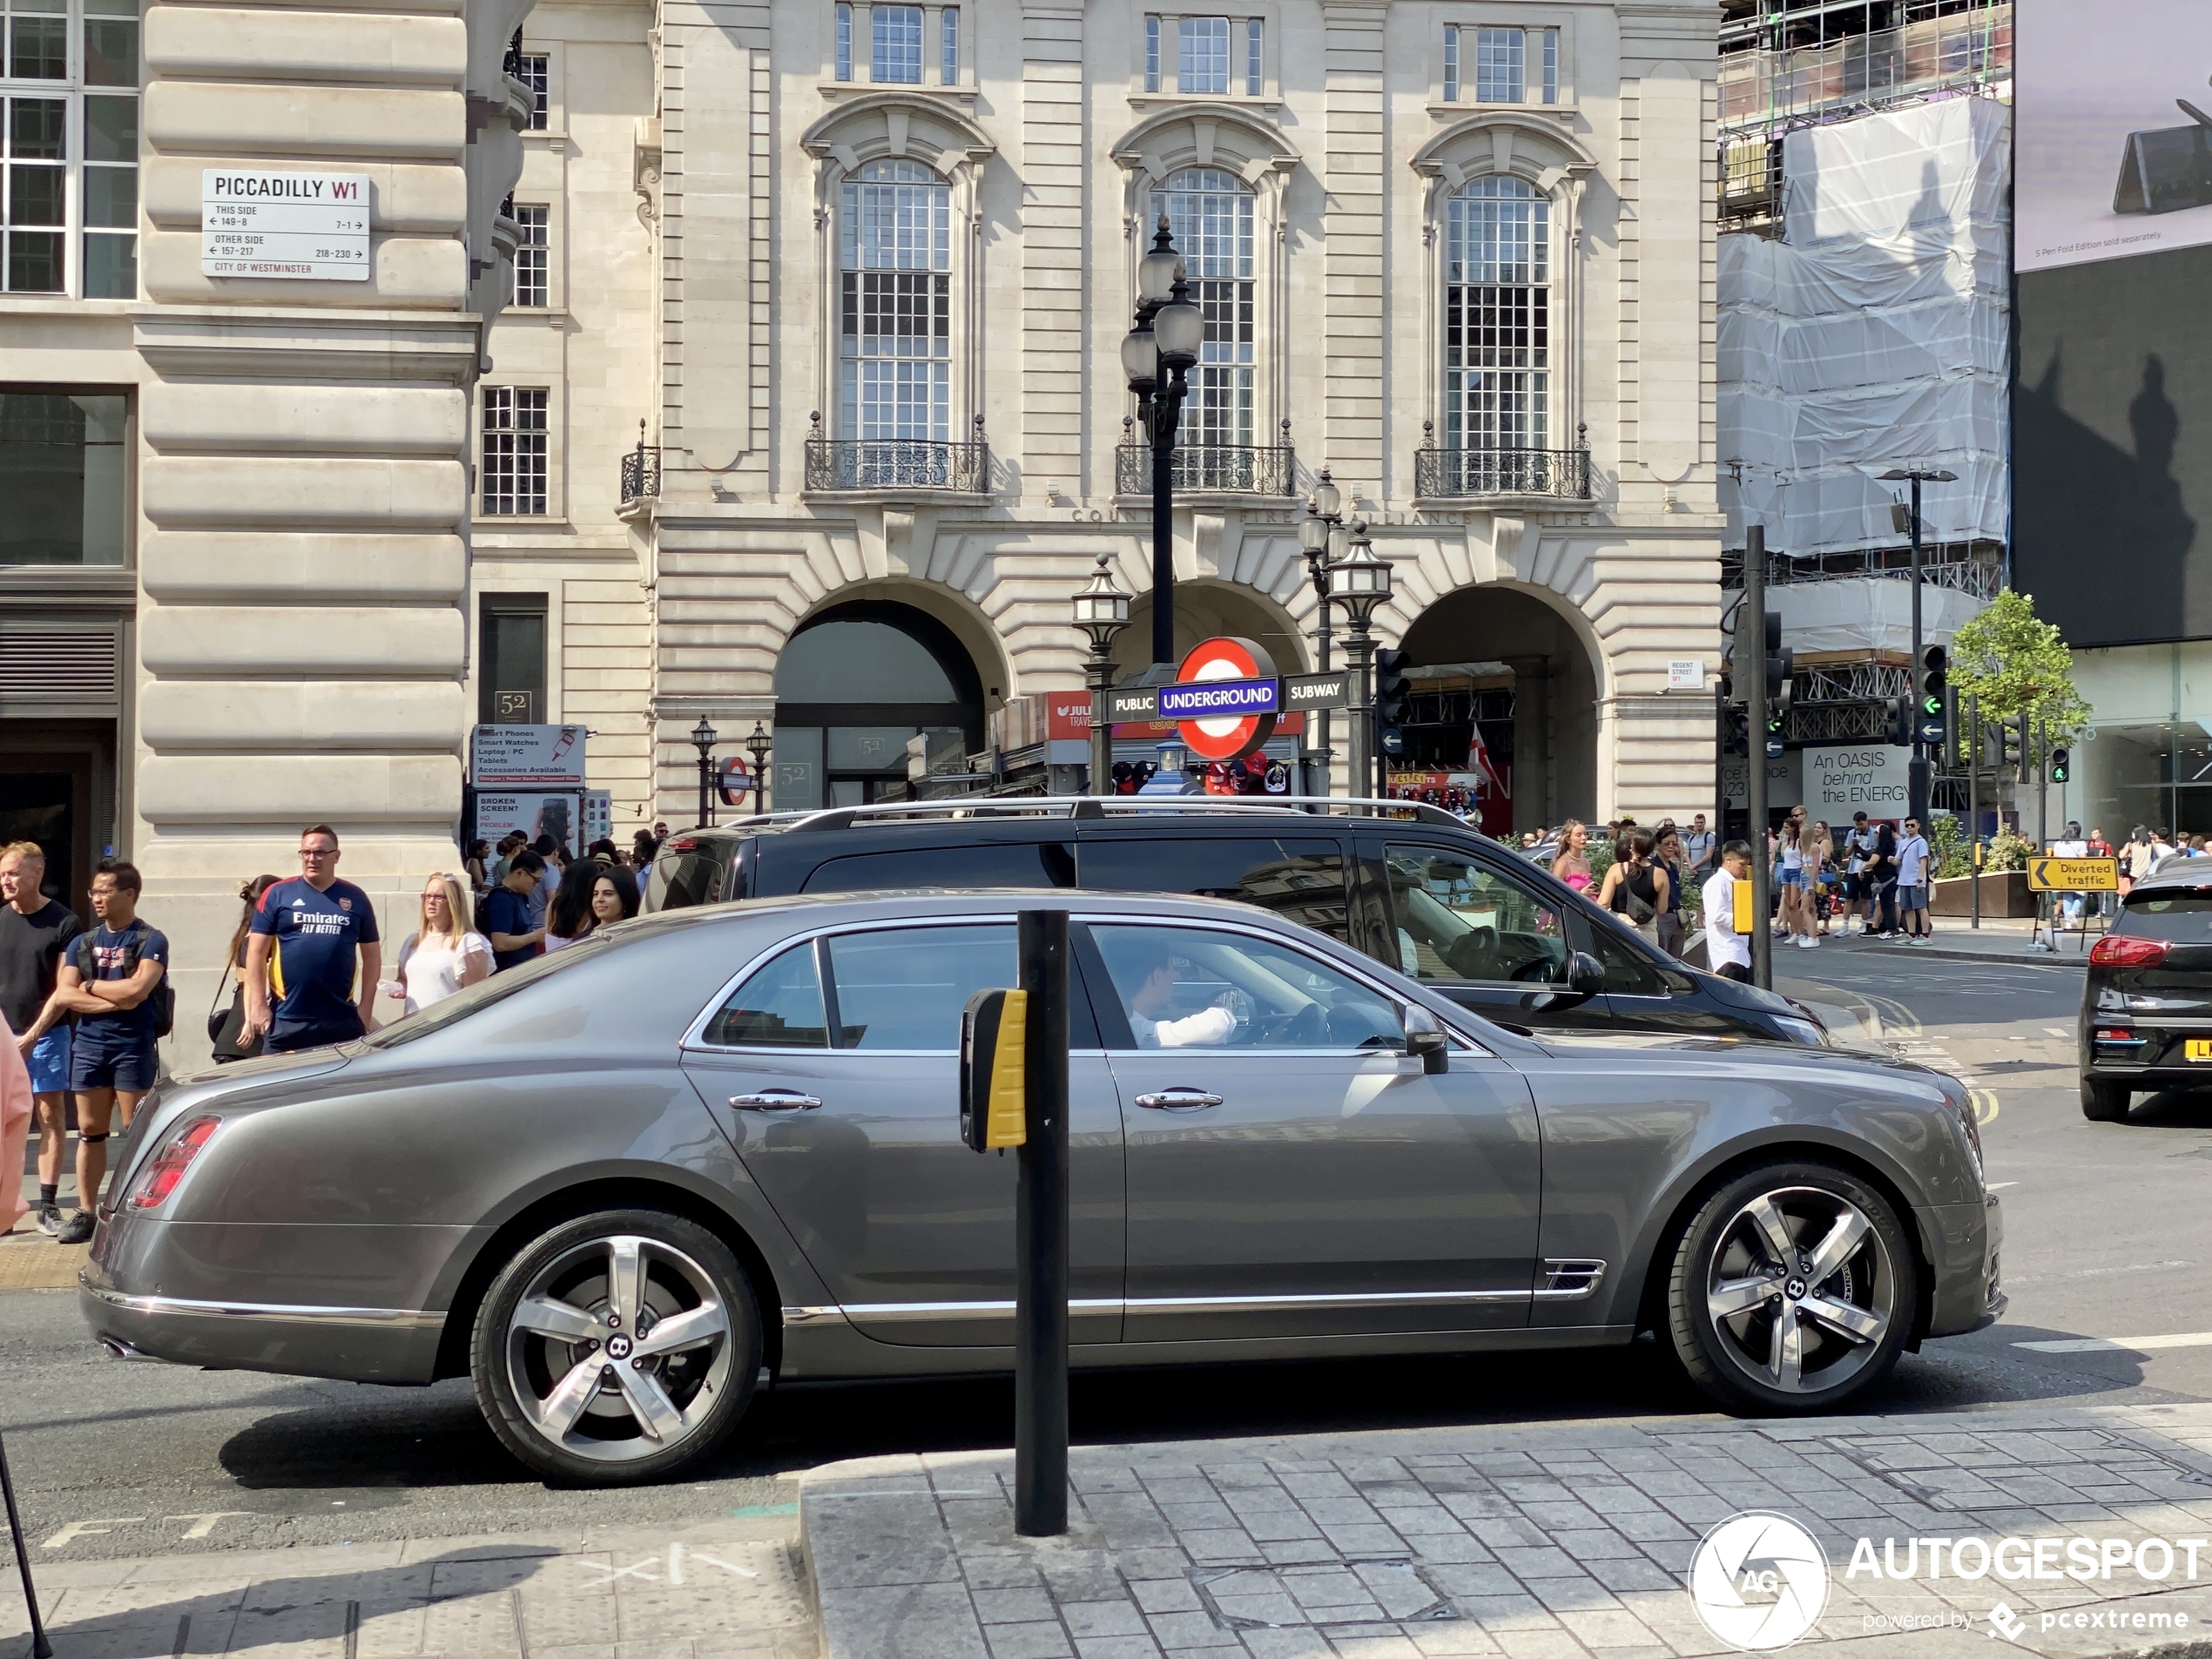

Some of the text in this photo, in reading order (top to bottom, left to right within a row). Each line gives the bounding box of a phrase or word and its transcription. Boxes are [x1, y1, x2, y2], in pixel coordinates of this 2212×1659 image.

[215, 177, 357, 199] PICCADILLY W1
[216, 206, 257, 215] THIS SIDE
[222, 218, 247, 226] 149-8
[215, 235, 264, 245] OTHER SIDE
[2042, 247, 2056, 256] Pen
[2058, 244, 2074, 253] Fold
[2075, 241, 2102, 252] Edition
[2103, 238, 2120, 247] sold
[2121, 231, 2164, 245] separately.
[316, 249, 350, 259] 218-230
[237, 263, 247, 272] OF
[250, 263, 312, 273] WESTMINSTER
[1240, 509, 1293, 523] FIRE
[1350, 511, 1473, 525] ALLIANCE
[1535, 513, 1590, 525] LIFE
[1116, 683, 1341, 711] PUBLIC UNDERGROUND SUBWAY
[501, 694, 527, 715] 52
[863, 740, 880, 755] 52
[1813, 752, 1885, 769] An OASIS
[781, 766, 806, 786] 52
[1822, 770, 1873, 786] behind
[1823, 789, 1845, 803] the
[2060, 863, 2111, 873] Diverted
[2067, 875, 2106, 885] traffic
[293, 912, 350, 926] Emirates
[301, 923, 342, 935] FLY BETTER
